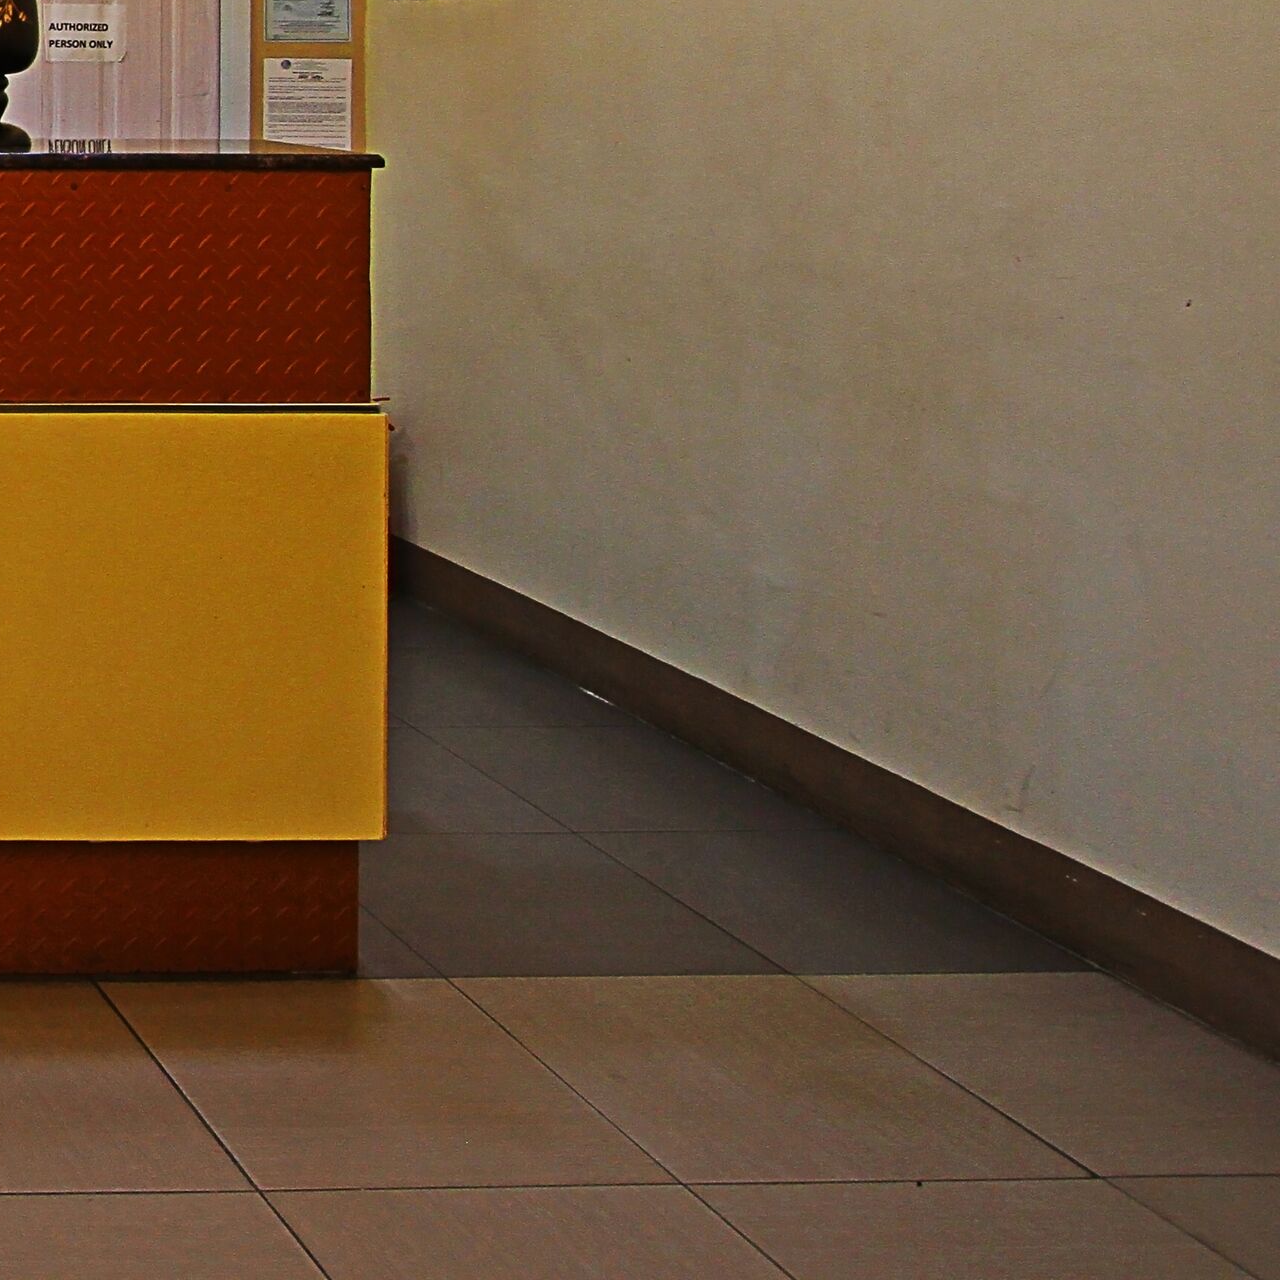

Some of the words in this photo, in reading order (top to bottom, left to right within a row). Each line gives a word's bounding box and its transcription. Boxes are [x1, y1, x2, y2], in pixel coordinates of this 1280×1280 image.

[49, 22, 109, 32] AUTHORIZED
[49, 39, 86, 48] PERSON
[89, 40, 113, 49] ONLY
